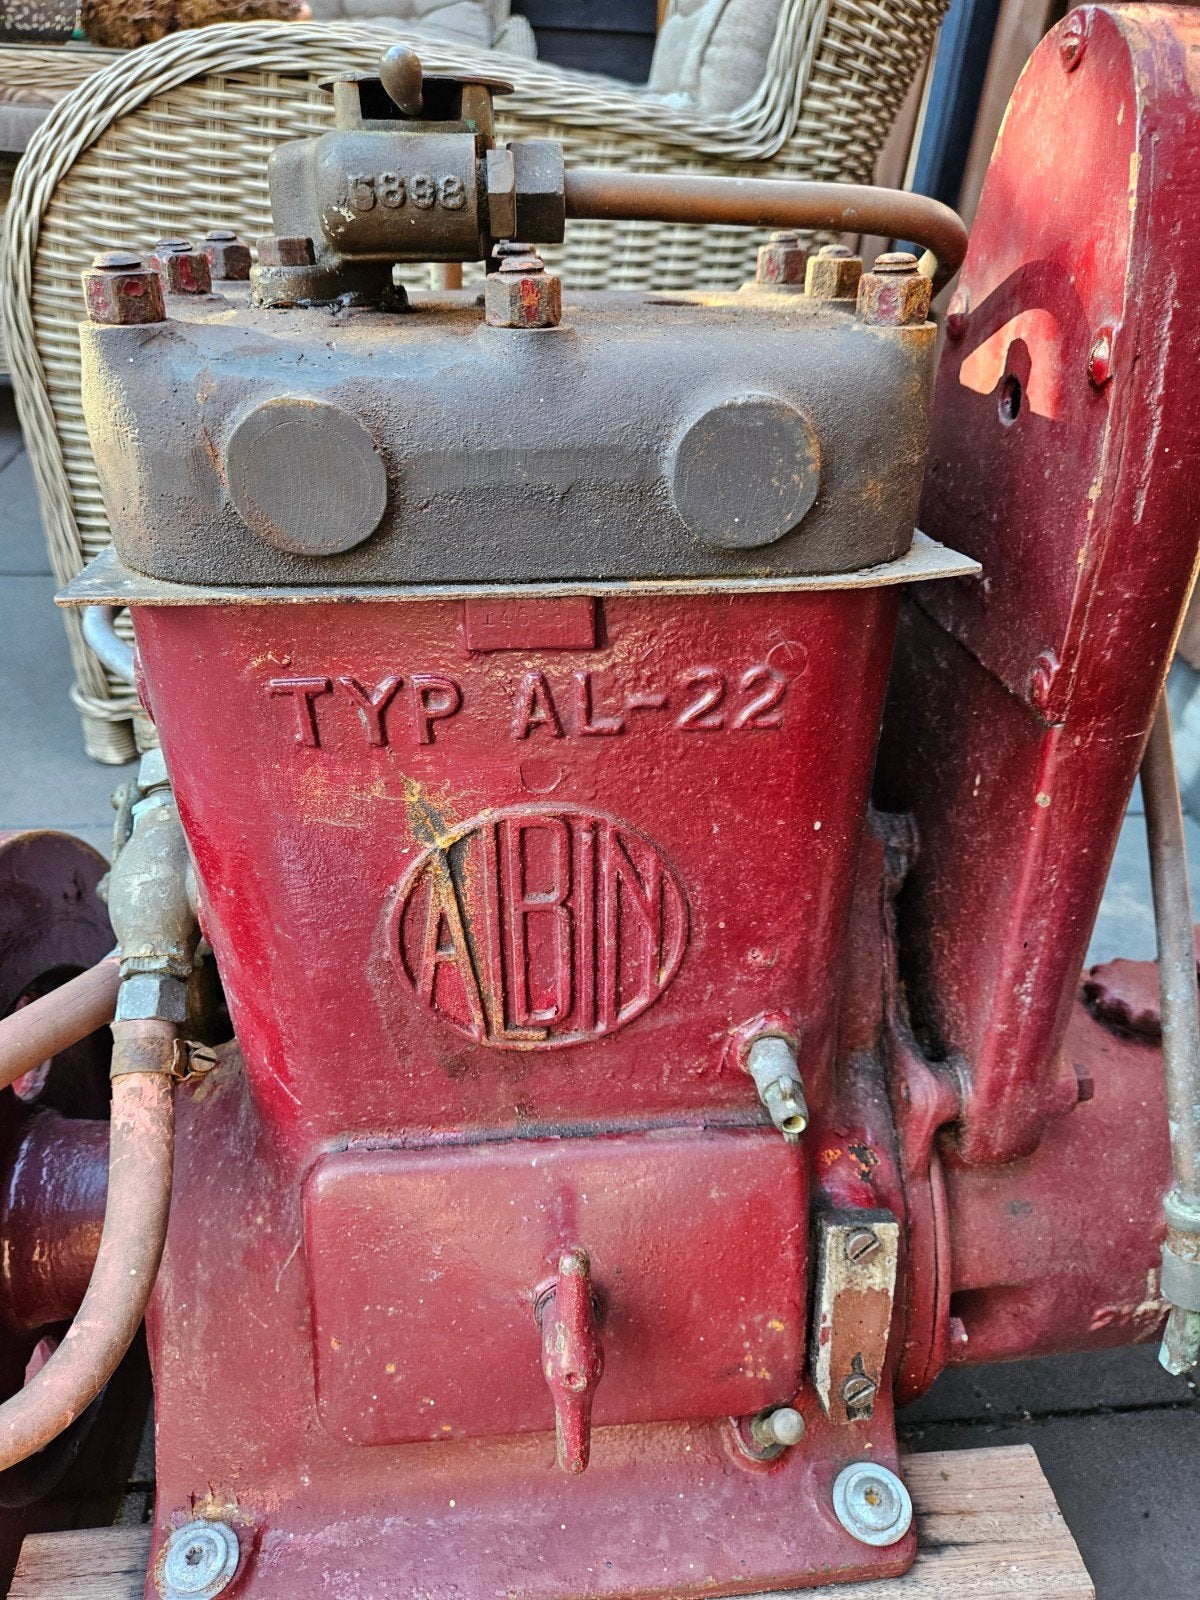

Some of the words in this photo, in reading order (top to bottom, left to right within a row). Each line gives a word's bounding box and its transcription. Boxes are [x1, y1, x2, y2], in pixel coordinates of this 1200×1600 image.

[266, 674, 463, 748] TYP
[512, 665, 787, 739] AL-22
[411, 810, 670, 1045] ALBIN
